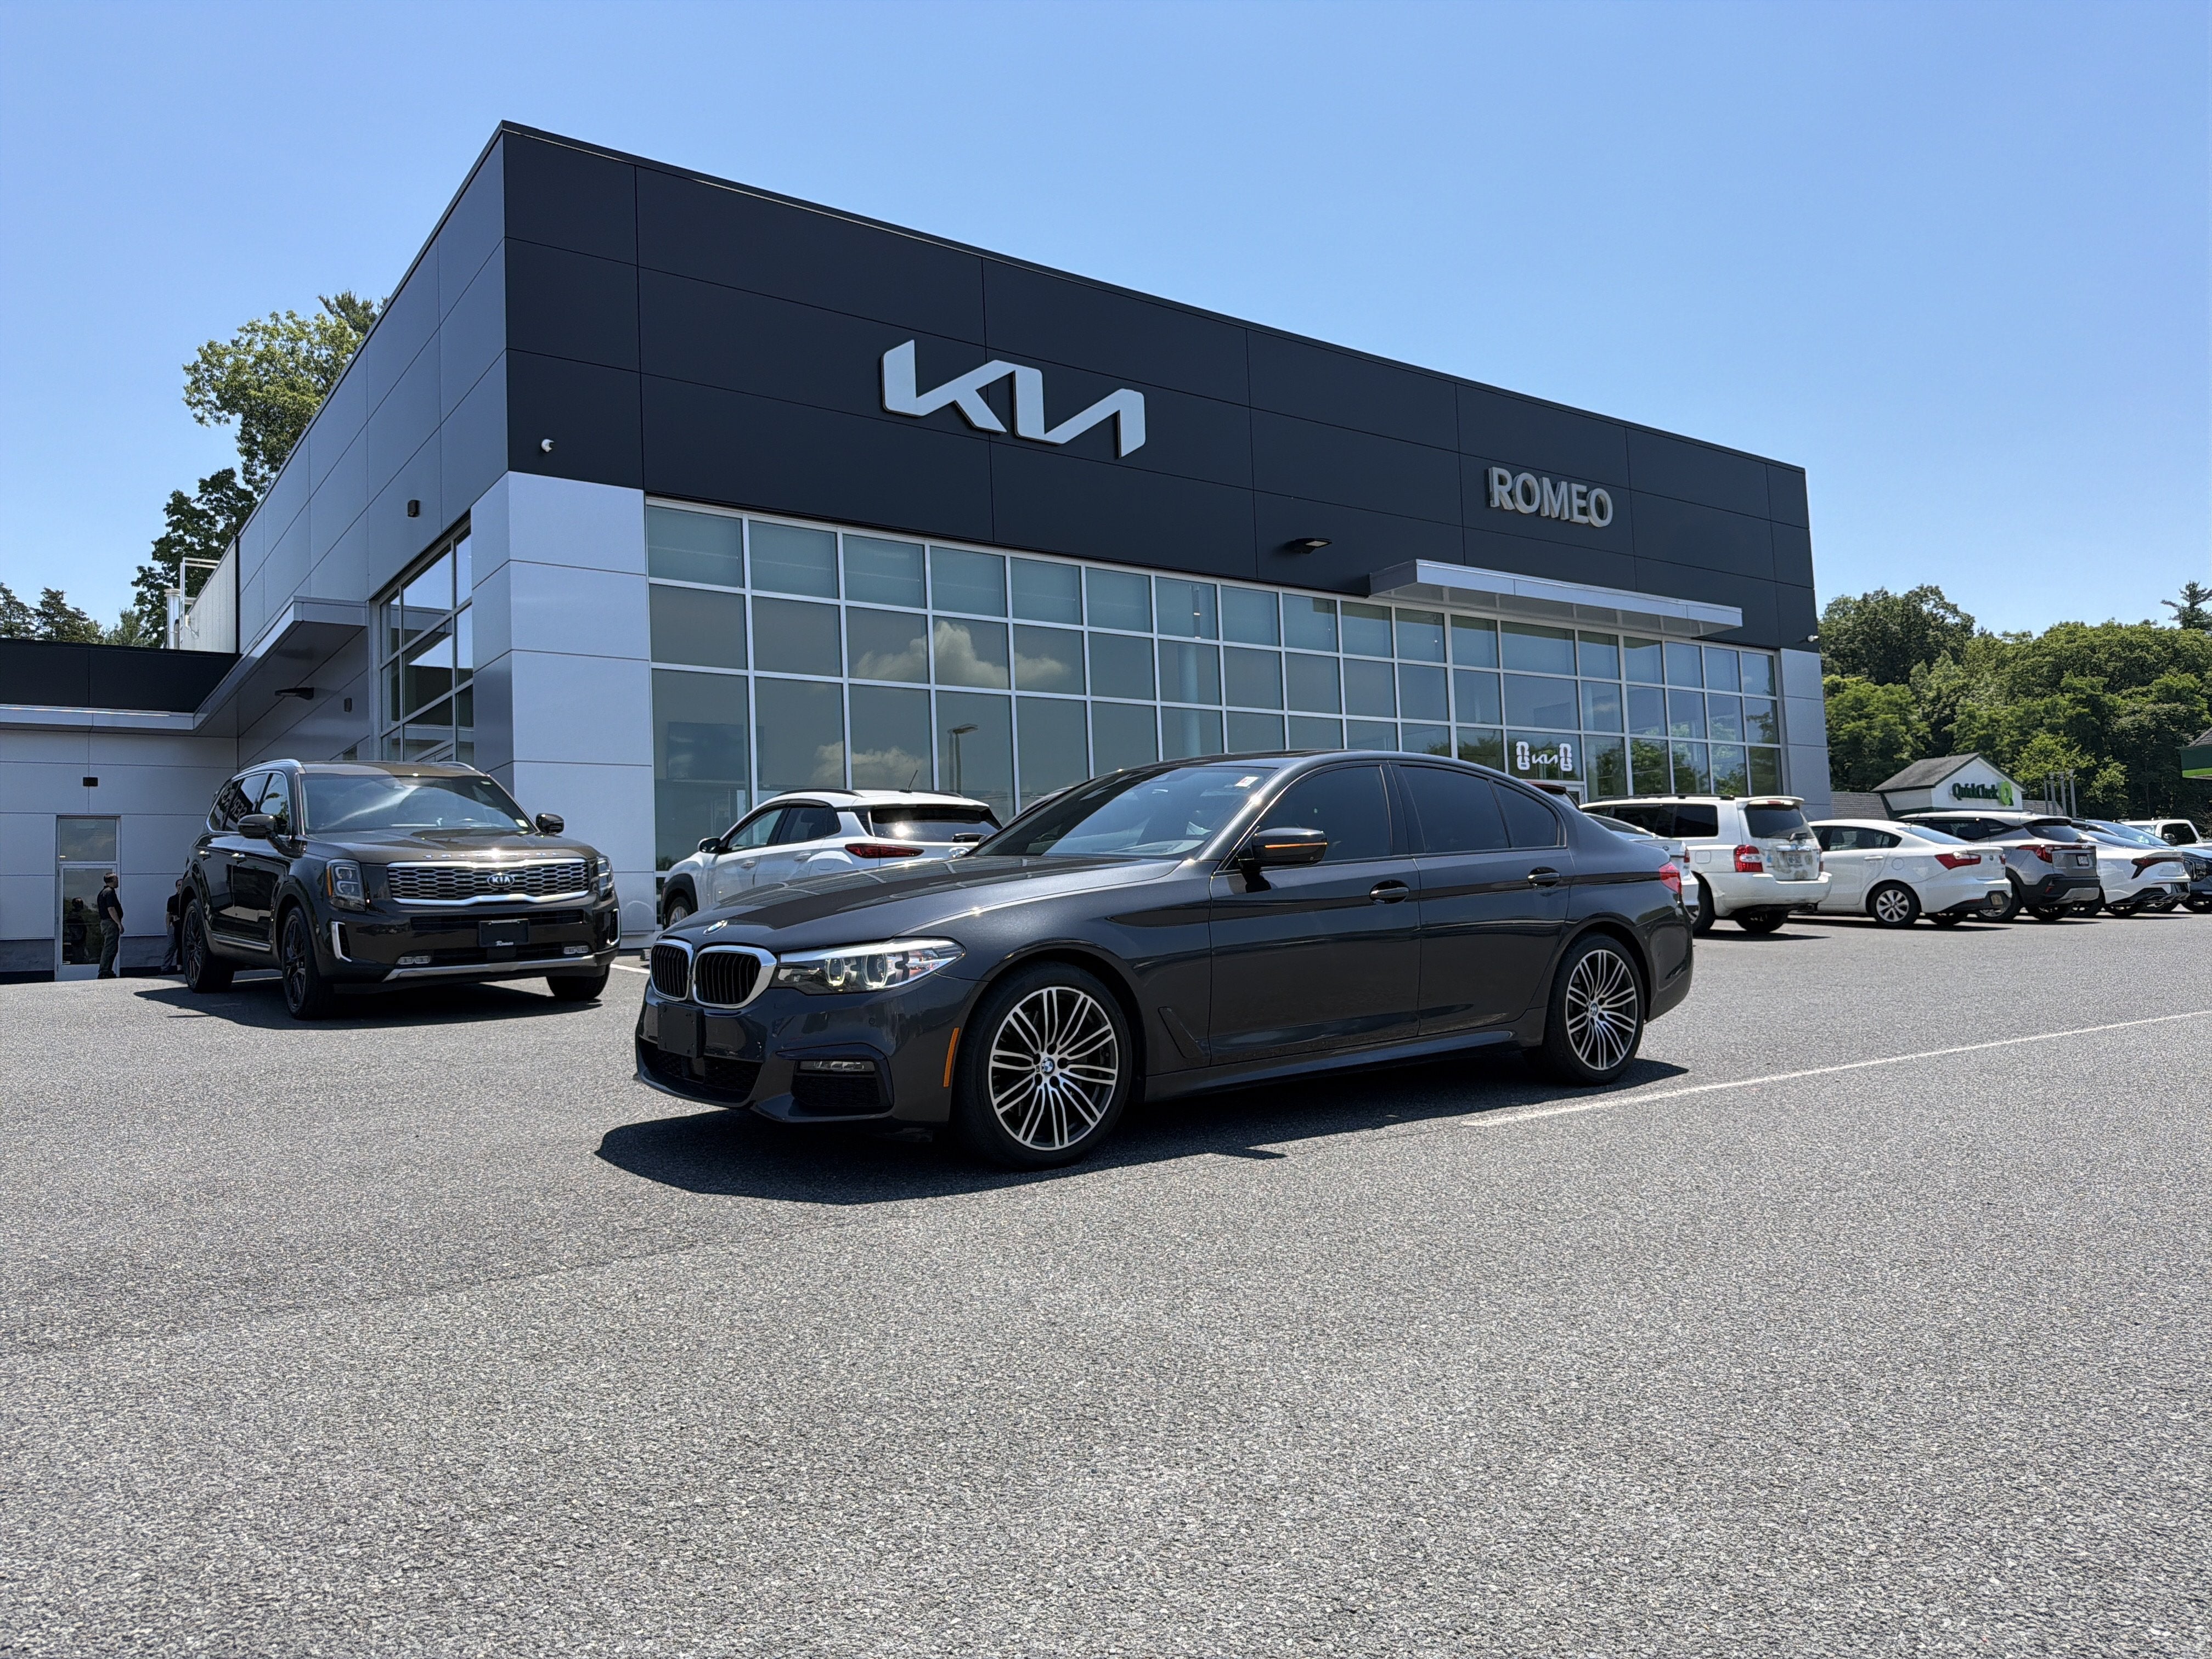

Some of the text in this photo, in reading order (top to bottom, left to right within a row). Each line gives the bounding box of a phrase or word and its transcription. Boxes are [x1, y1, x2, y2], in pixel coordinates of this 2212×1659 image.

[881, 339, 1146, 459] KIA
[1488, 467, 1613, 528] ROMEO
[492, 876, 511, 884] KIA
